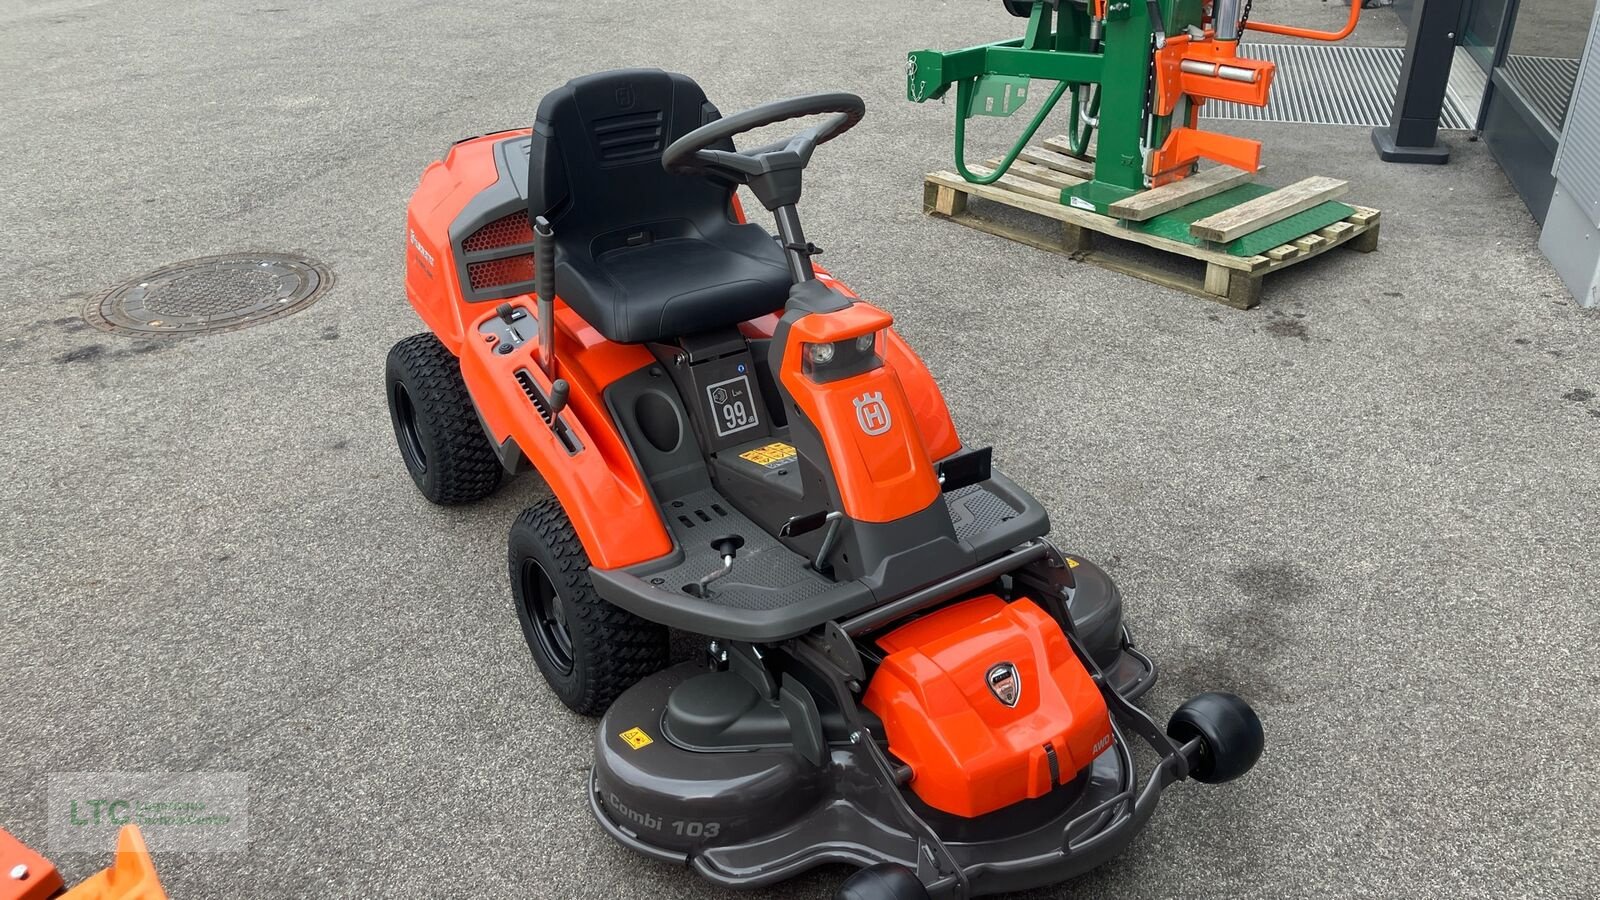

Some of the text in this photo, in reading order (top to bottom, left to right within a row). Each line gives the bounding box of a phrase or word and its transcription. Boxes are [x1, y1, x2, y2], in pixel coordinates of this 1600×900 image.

[723, 401, 747, 428] 99
[1092, 734, 1110, 753] AWD
[609, 792, 721, 838] Combi 103
